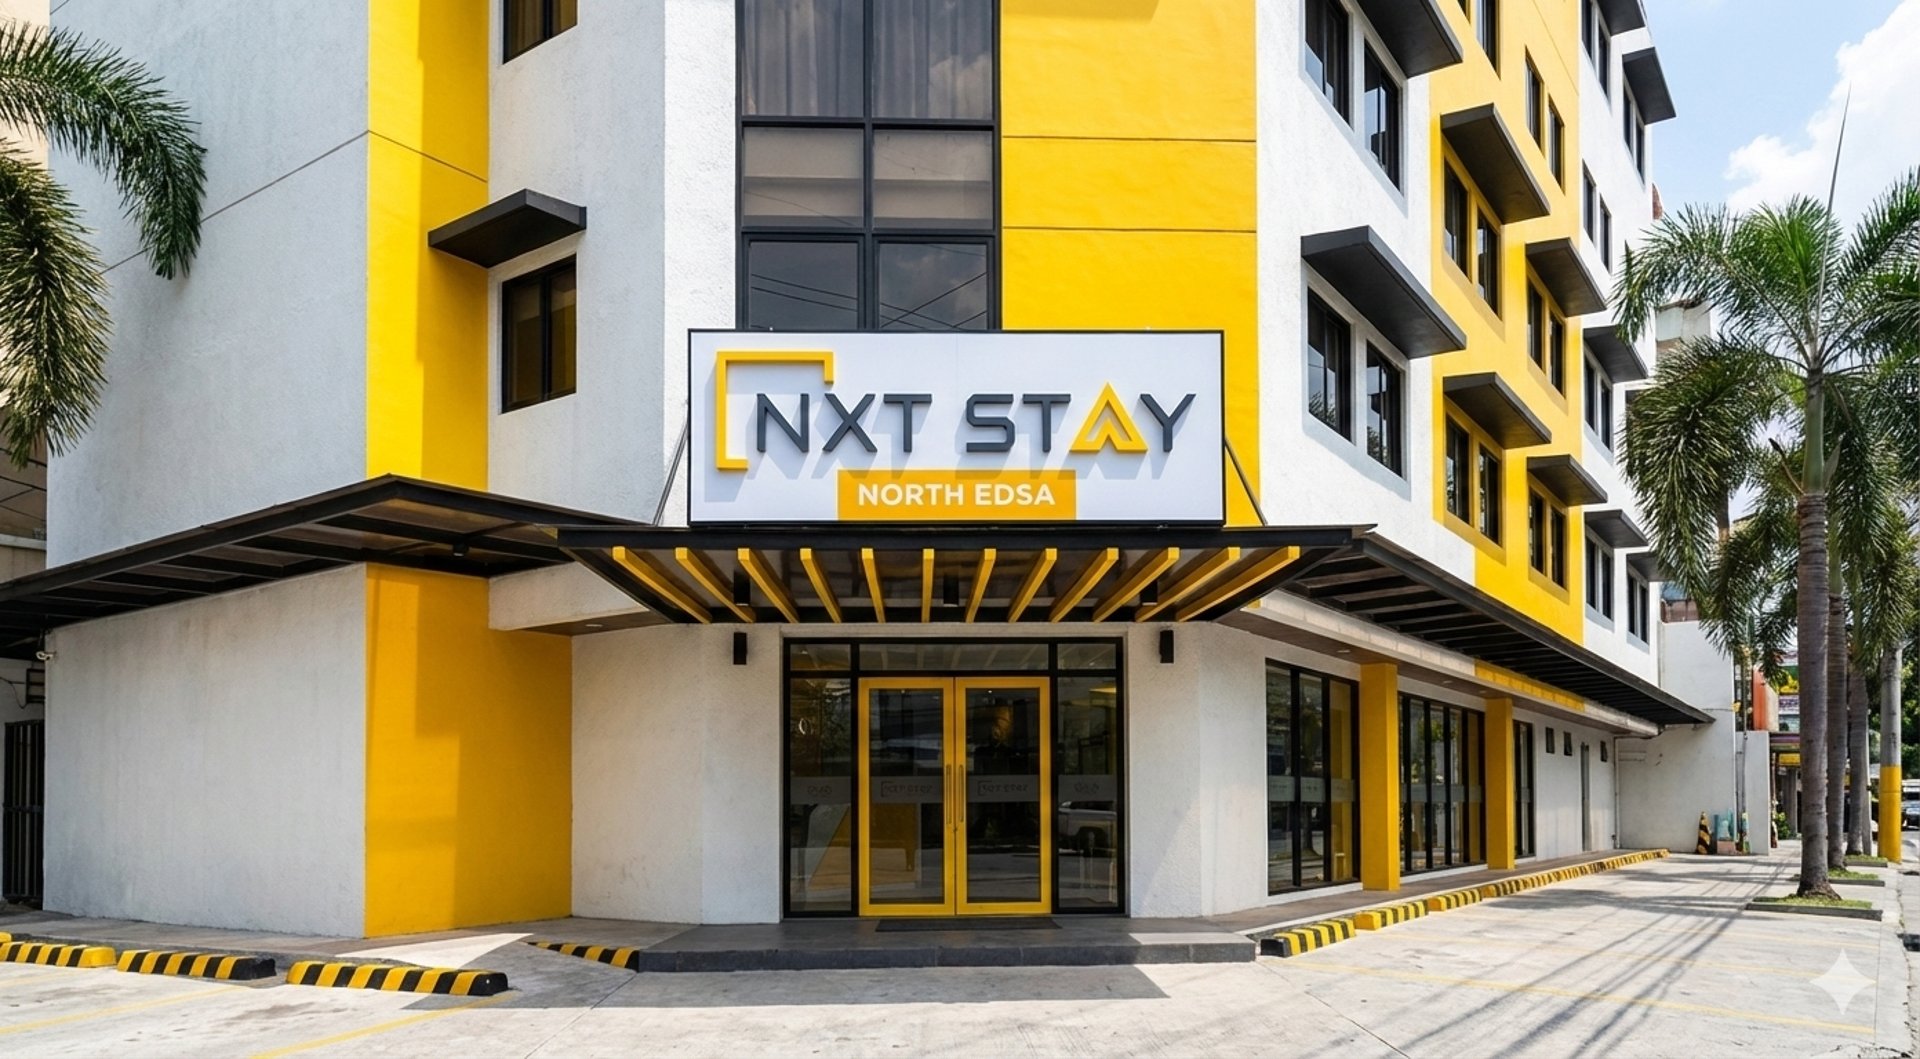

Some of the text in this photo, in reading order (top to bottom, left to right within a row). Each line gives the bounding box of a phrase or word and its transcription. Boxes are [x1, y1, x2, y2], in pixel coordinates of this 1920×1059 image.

[757, 382, 1197, 453] NXT STAY
[858, 483, 1056, 506] NORTH EDSA
